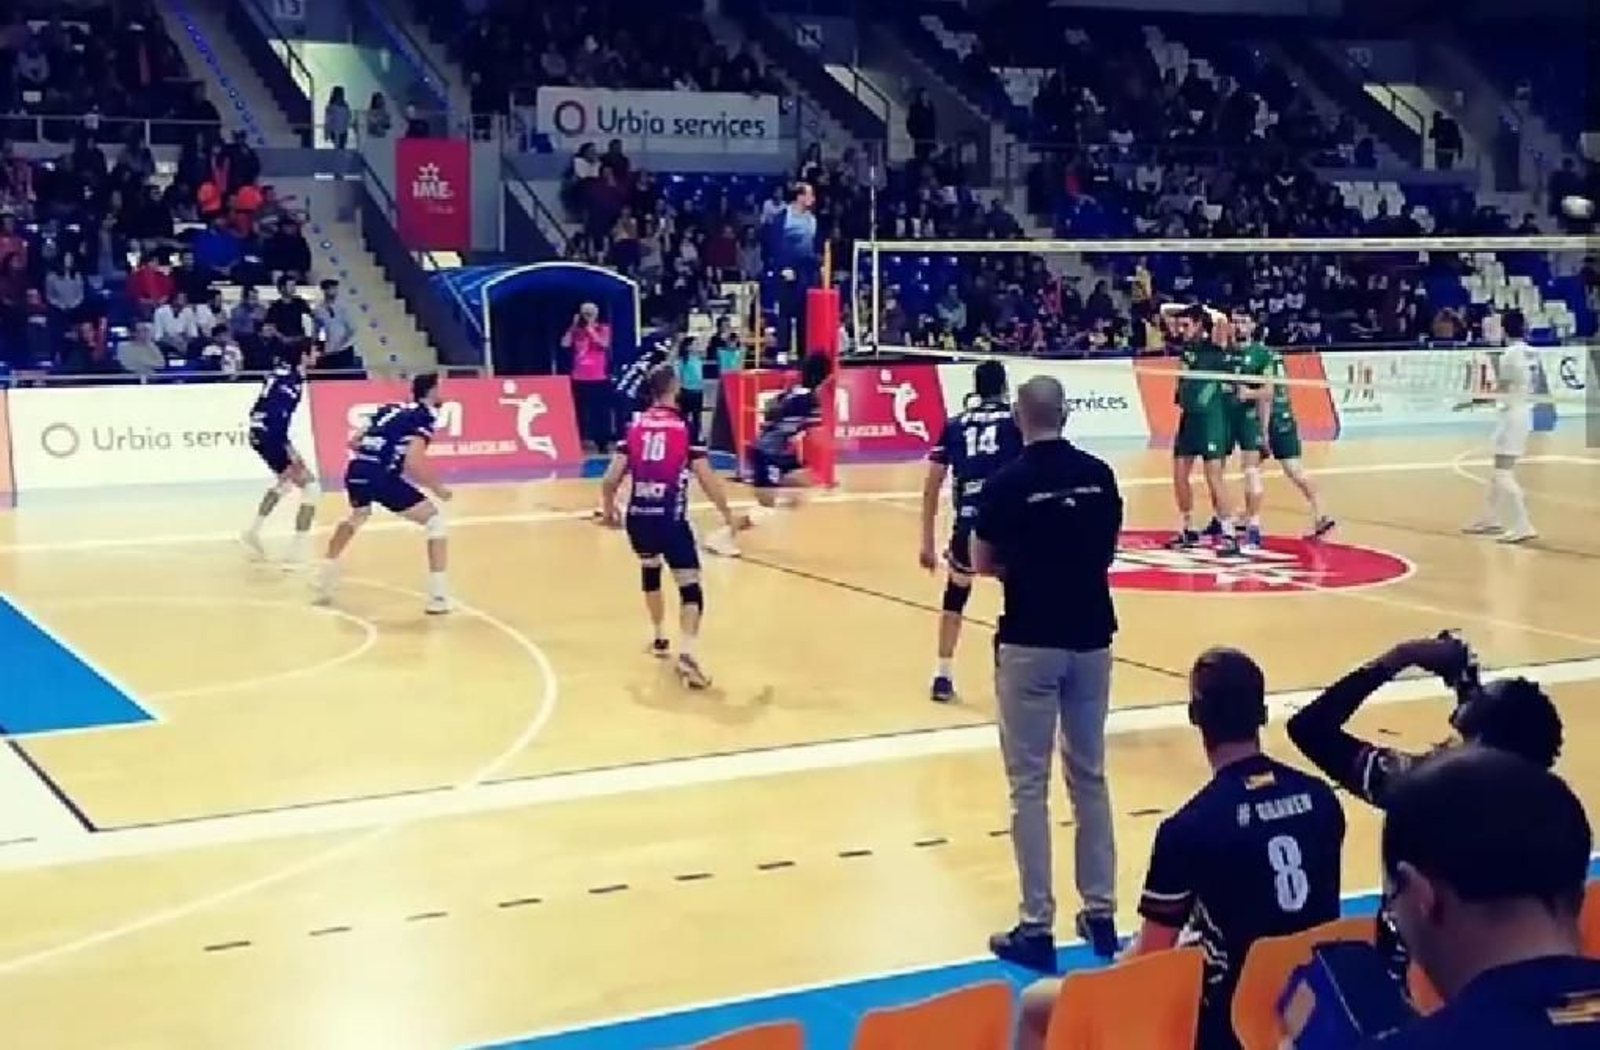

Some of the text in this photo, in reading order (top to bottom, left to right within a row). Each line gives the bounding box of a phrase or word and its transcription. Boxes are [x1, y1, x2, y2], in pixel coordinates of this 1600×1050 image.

[597, 105, 767, 137] Urbia services
[1064, 391, 1129, 411] ervices
[91, 422, 245, 451] Urbia servi
[963, 425, 1000, 457] 14
[1267, 835, 1309, 912] 8
